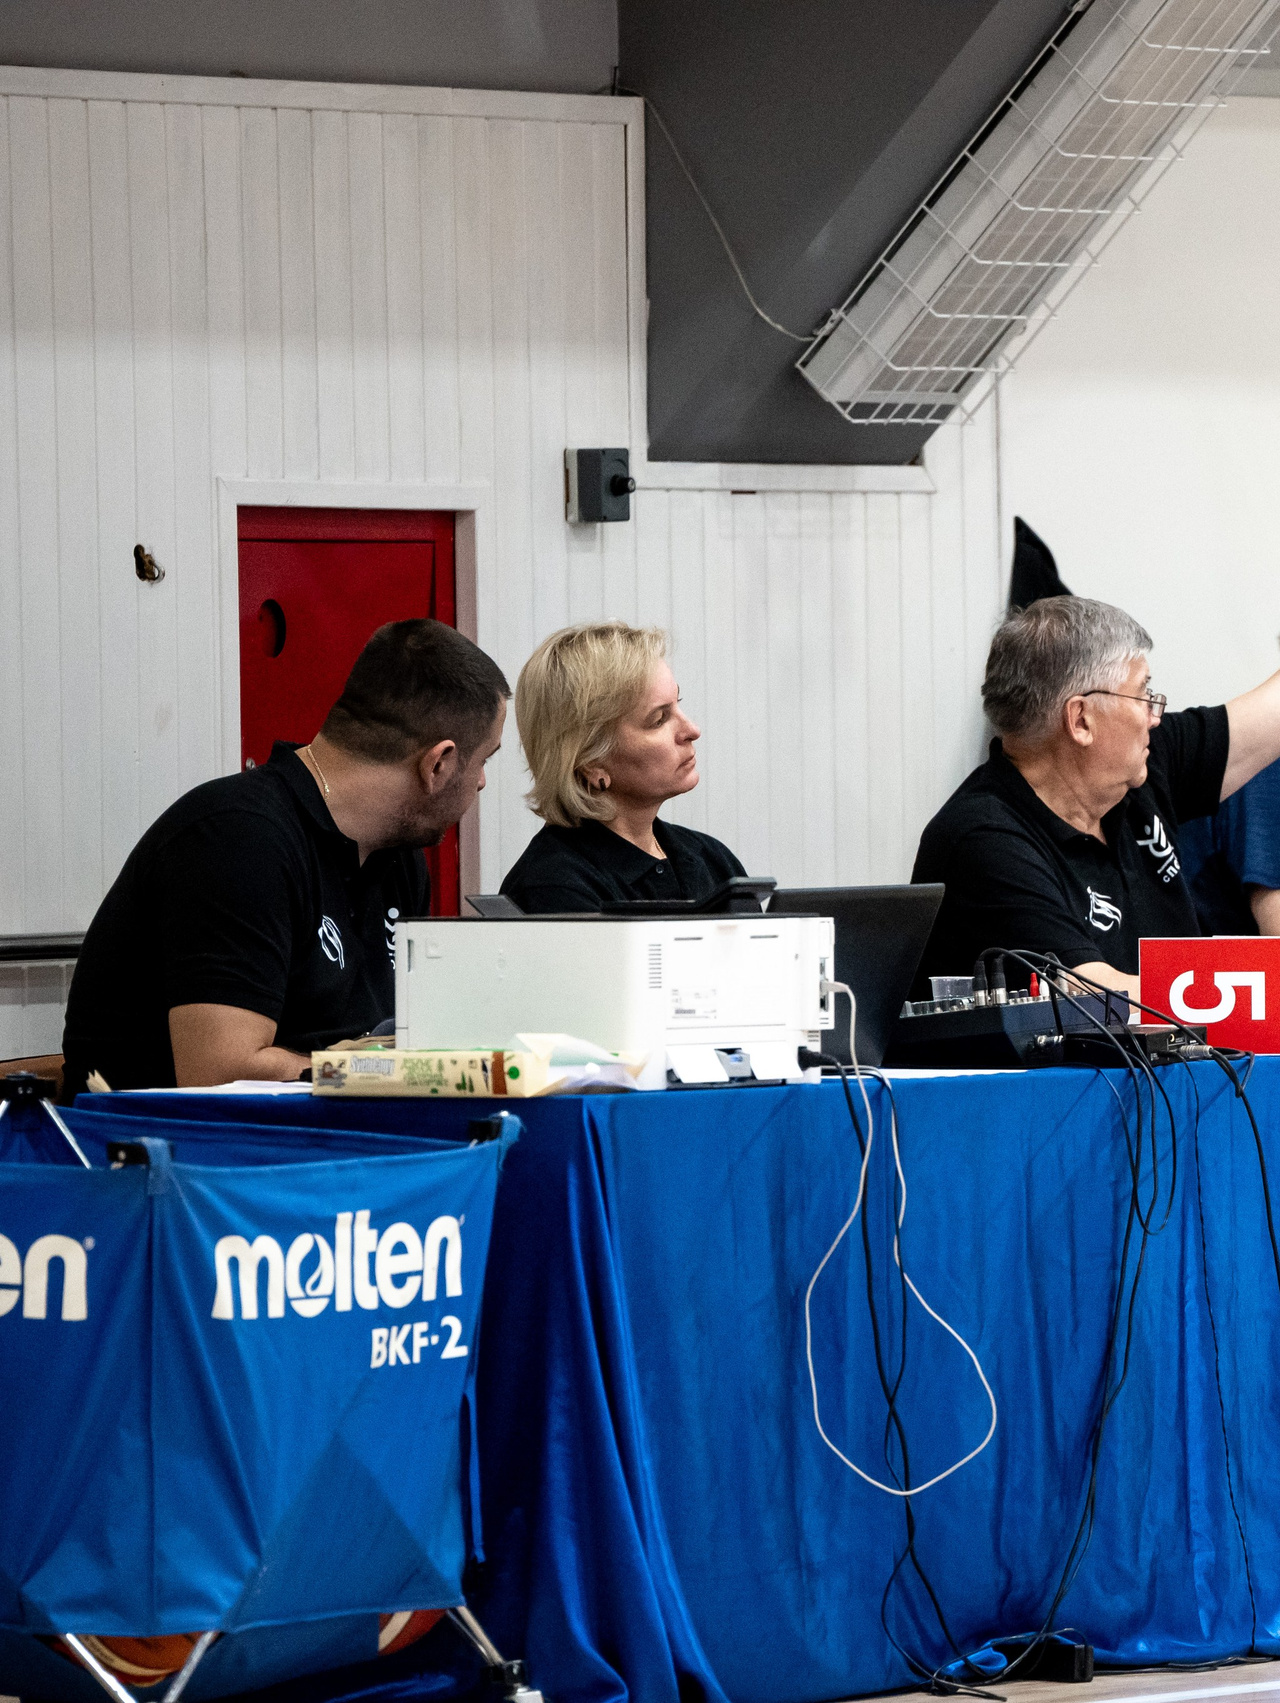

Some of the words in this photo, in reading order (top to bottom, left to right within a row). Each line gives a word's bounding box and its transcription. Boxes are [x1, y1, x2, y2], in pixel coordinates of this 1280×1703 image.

[1168, 969, 1266, 1024] 5
[211, 1209, 463, 1320] molten
[370, 1315, 469, 1369] BKF-2
